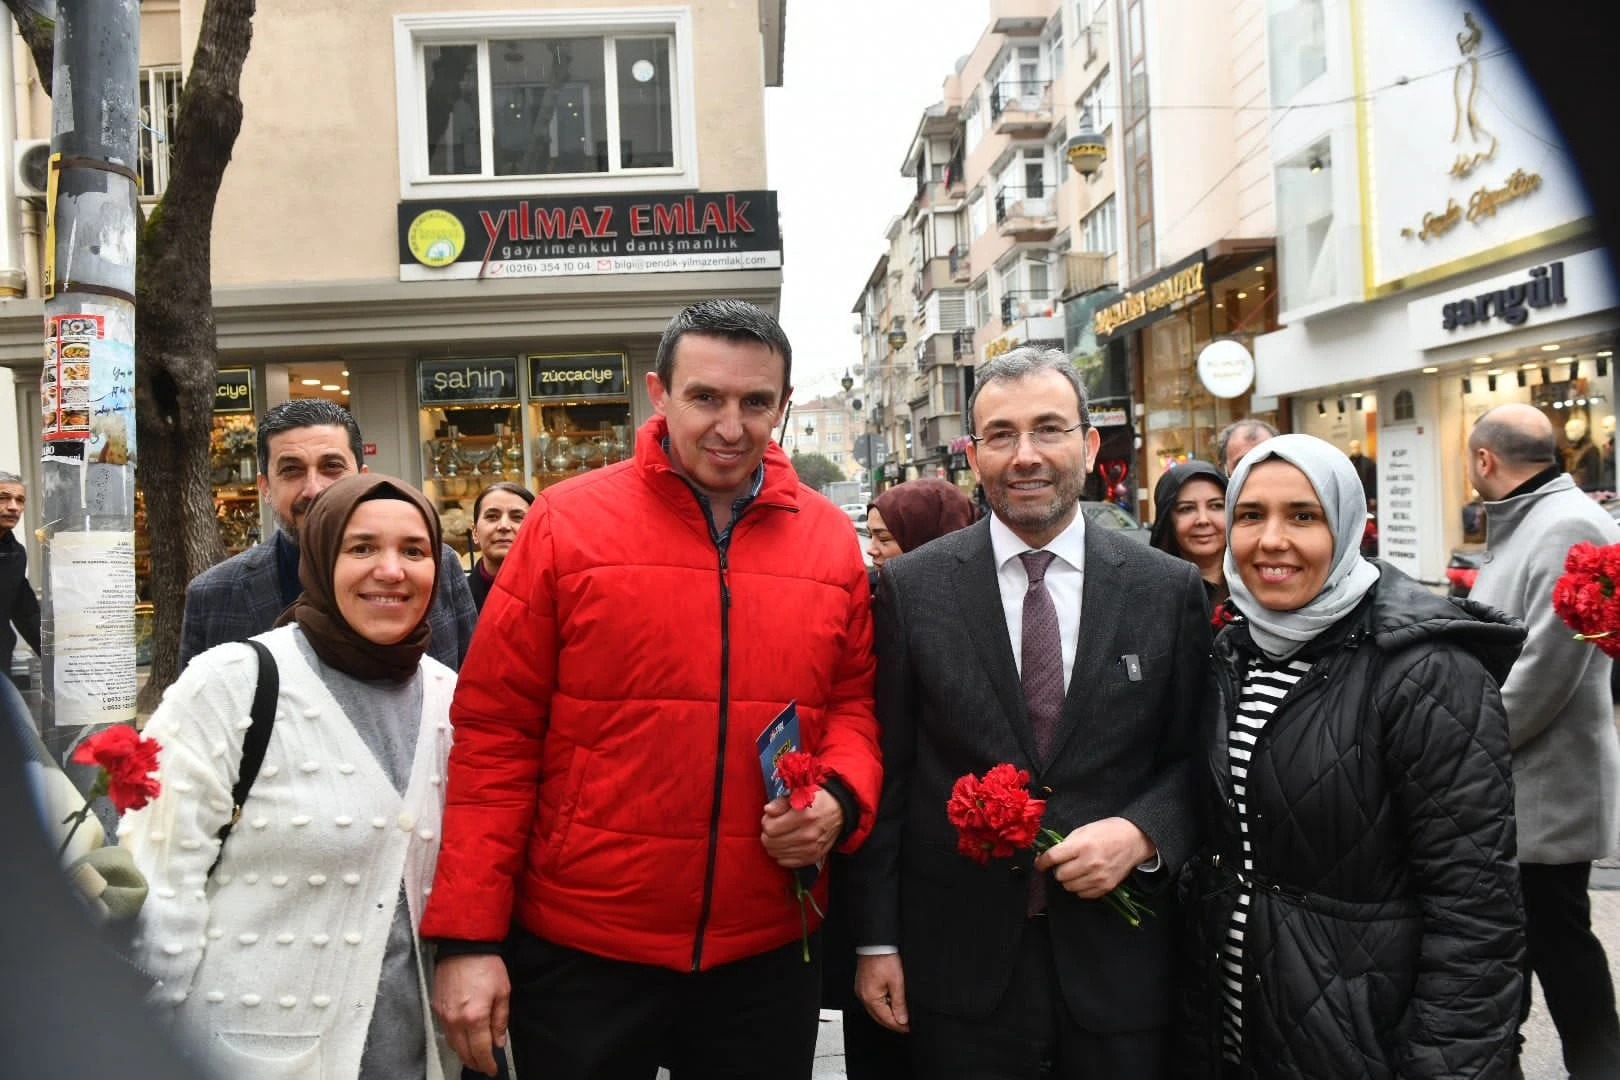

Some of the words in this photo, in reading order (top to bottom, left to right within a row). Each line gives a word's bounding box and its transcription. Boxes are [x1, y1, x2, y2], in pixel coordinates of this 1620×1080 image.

[629, 193, 756, 236] EMLAK
[502, 241, 617, 259] gayrimenkul
[626, 235, 738, 253] danışmanlık
[506, 264, 537, 273] (0216)
[541, 262, 560, 271] 354
[563, 262, 574, 270] 10
[577, 261, 591, 270] 04
[434, 367, 505, 391] şahin
[541, 367, 613, 384] züccaciye
